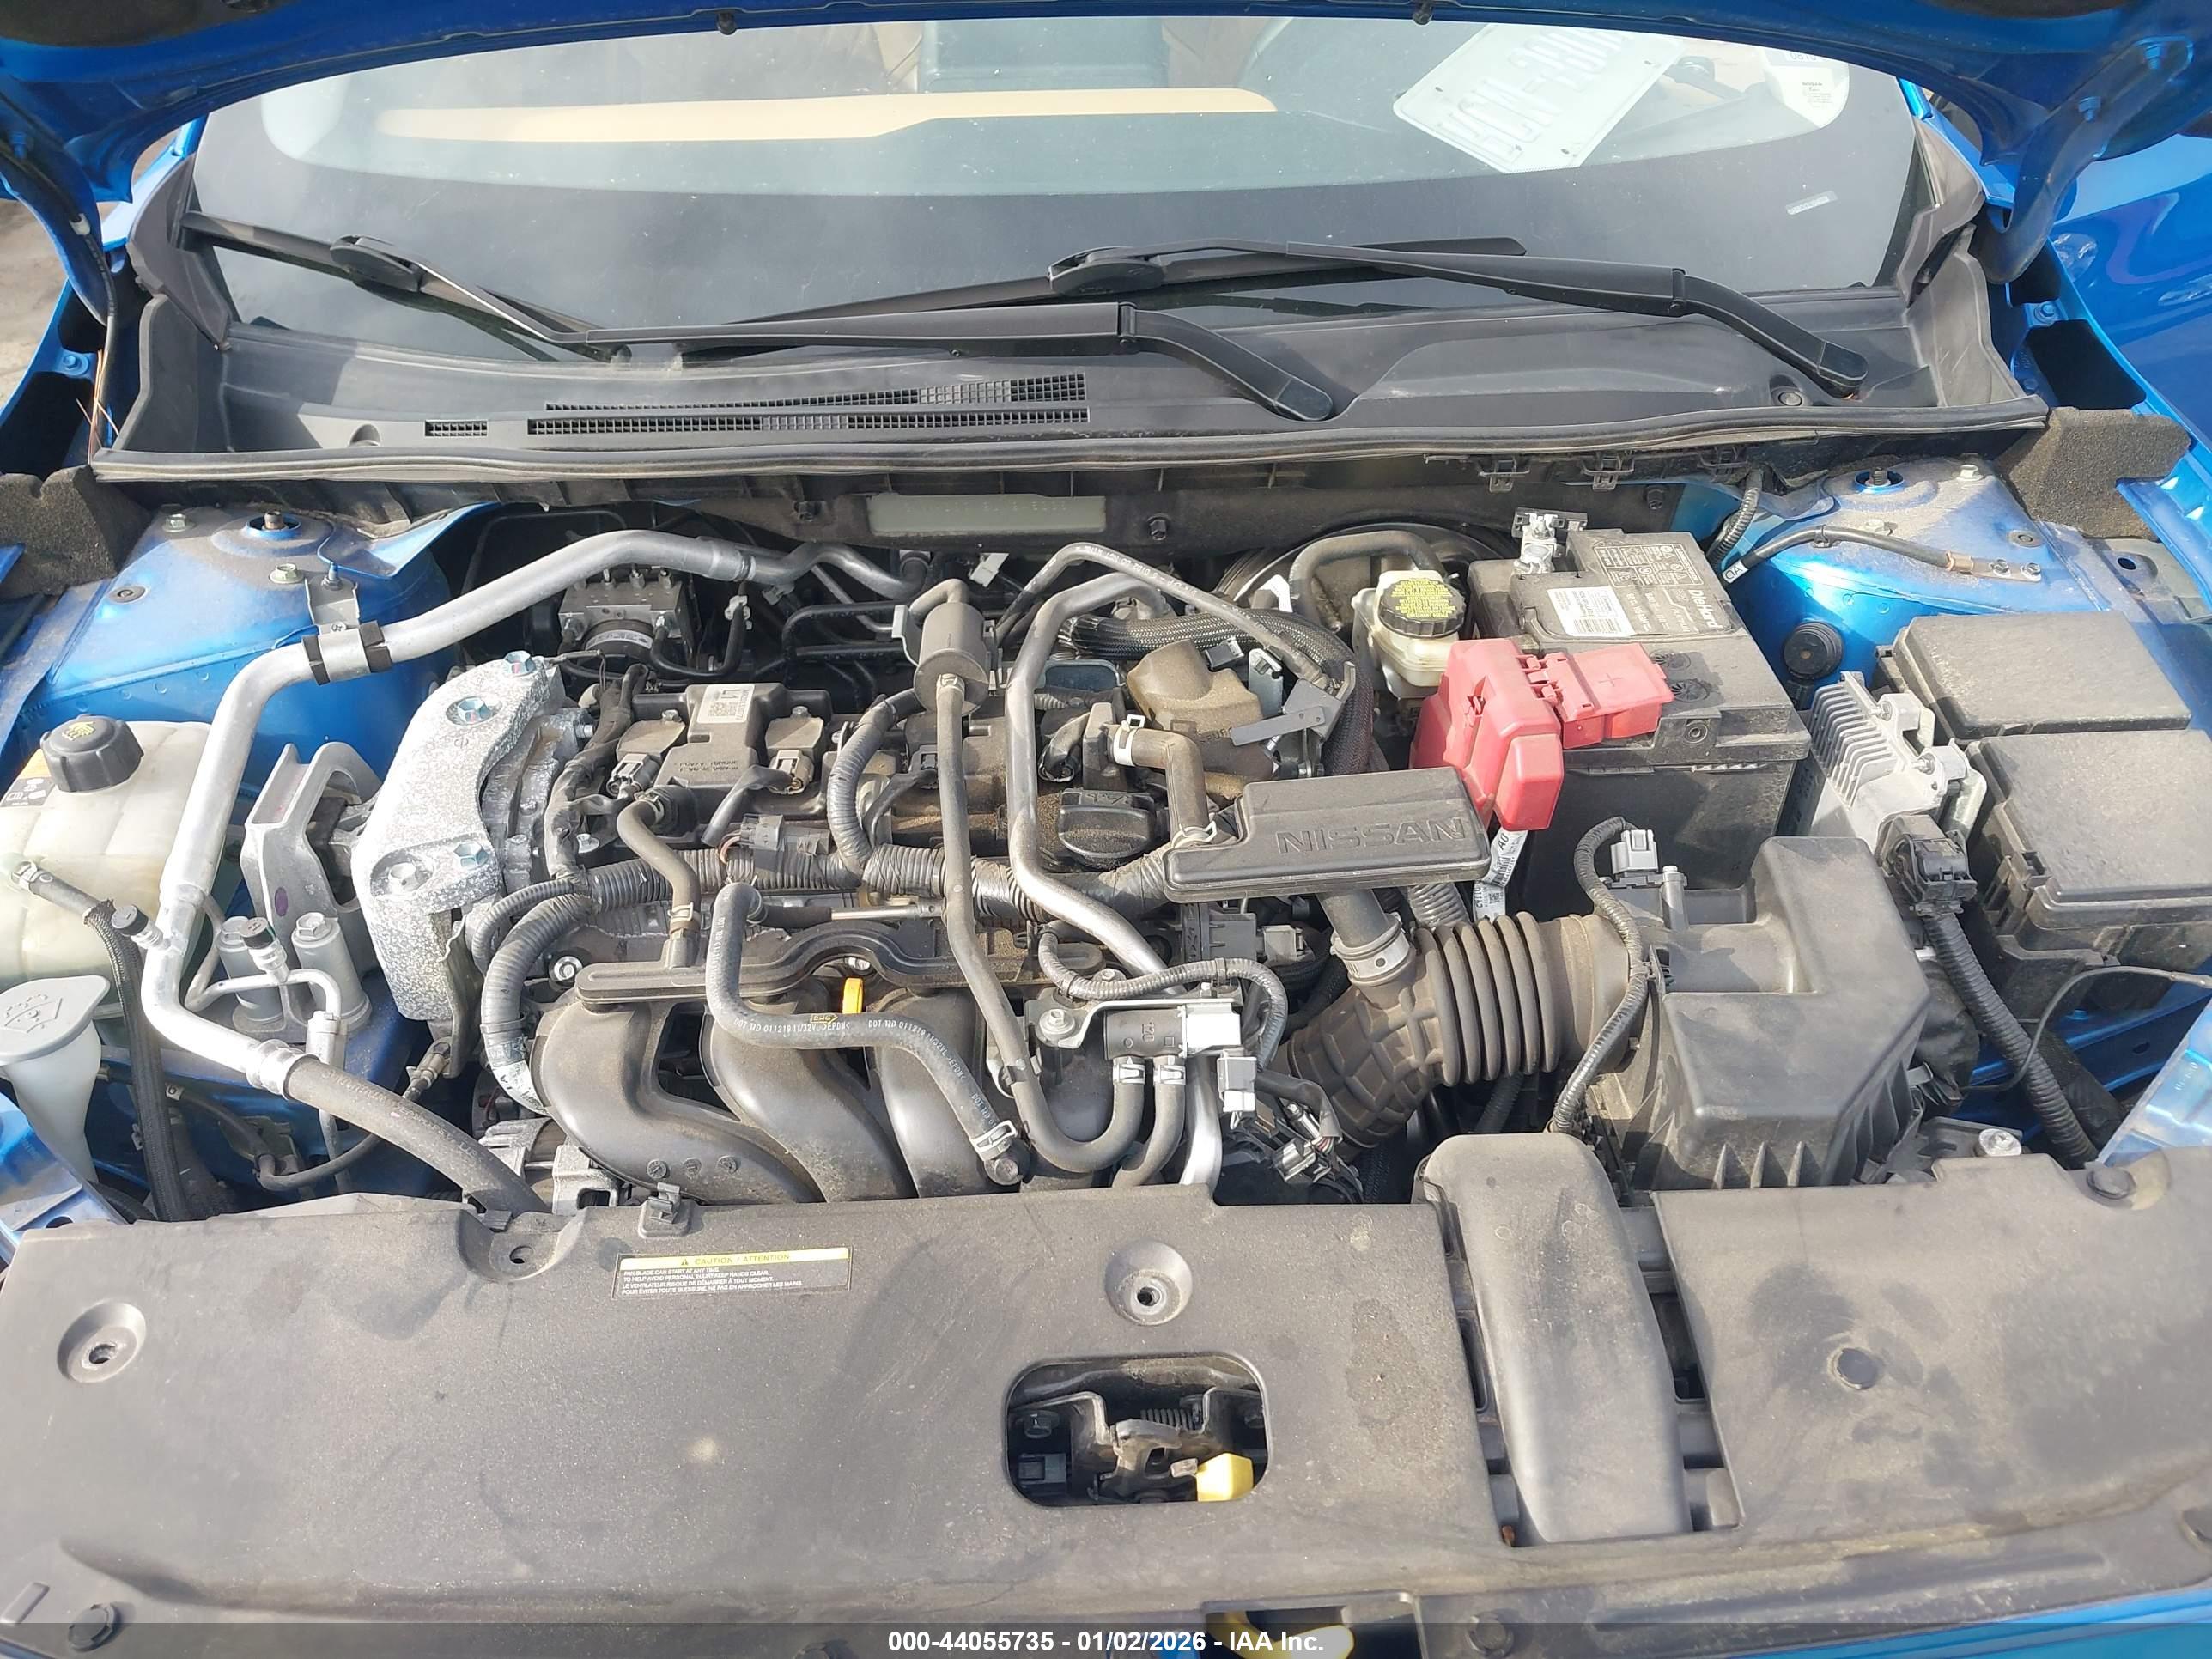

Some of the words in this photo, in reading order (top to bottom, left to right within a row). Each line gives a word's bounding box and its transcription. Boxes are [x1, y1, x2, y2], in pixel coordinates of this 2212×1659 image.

[1687, 589, 1723, 630] DieHard
[1276, 817, 1467, 854] NISSAN
[695, 1256, 733, 1266] CAUTION
[744, 1254, 790, 1263] ATTENTION
